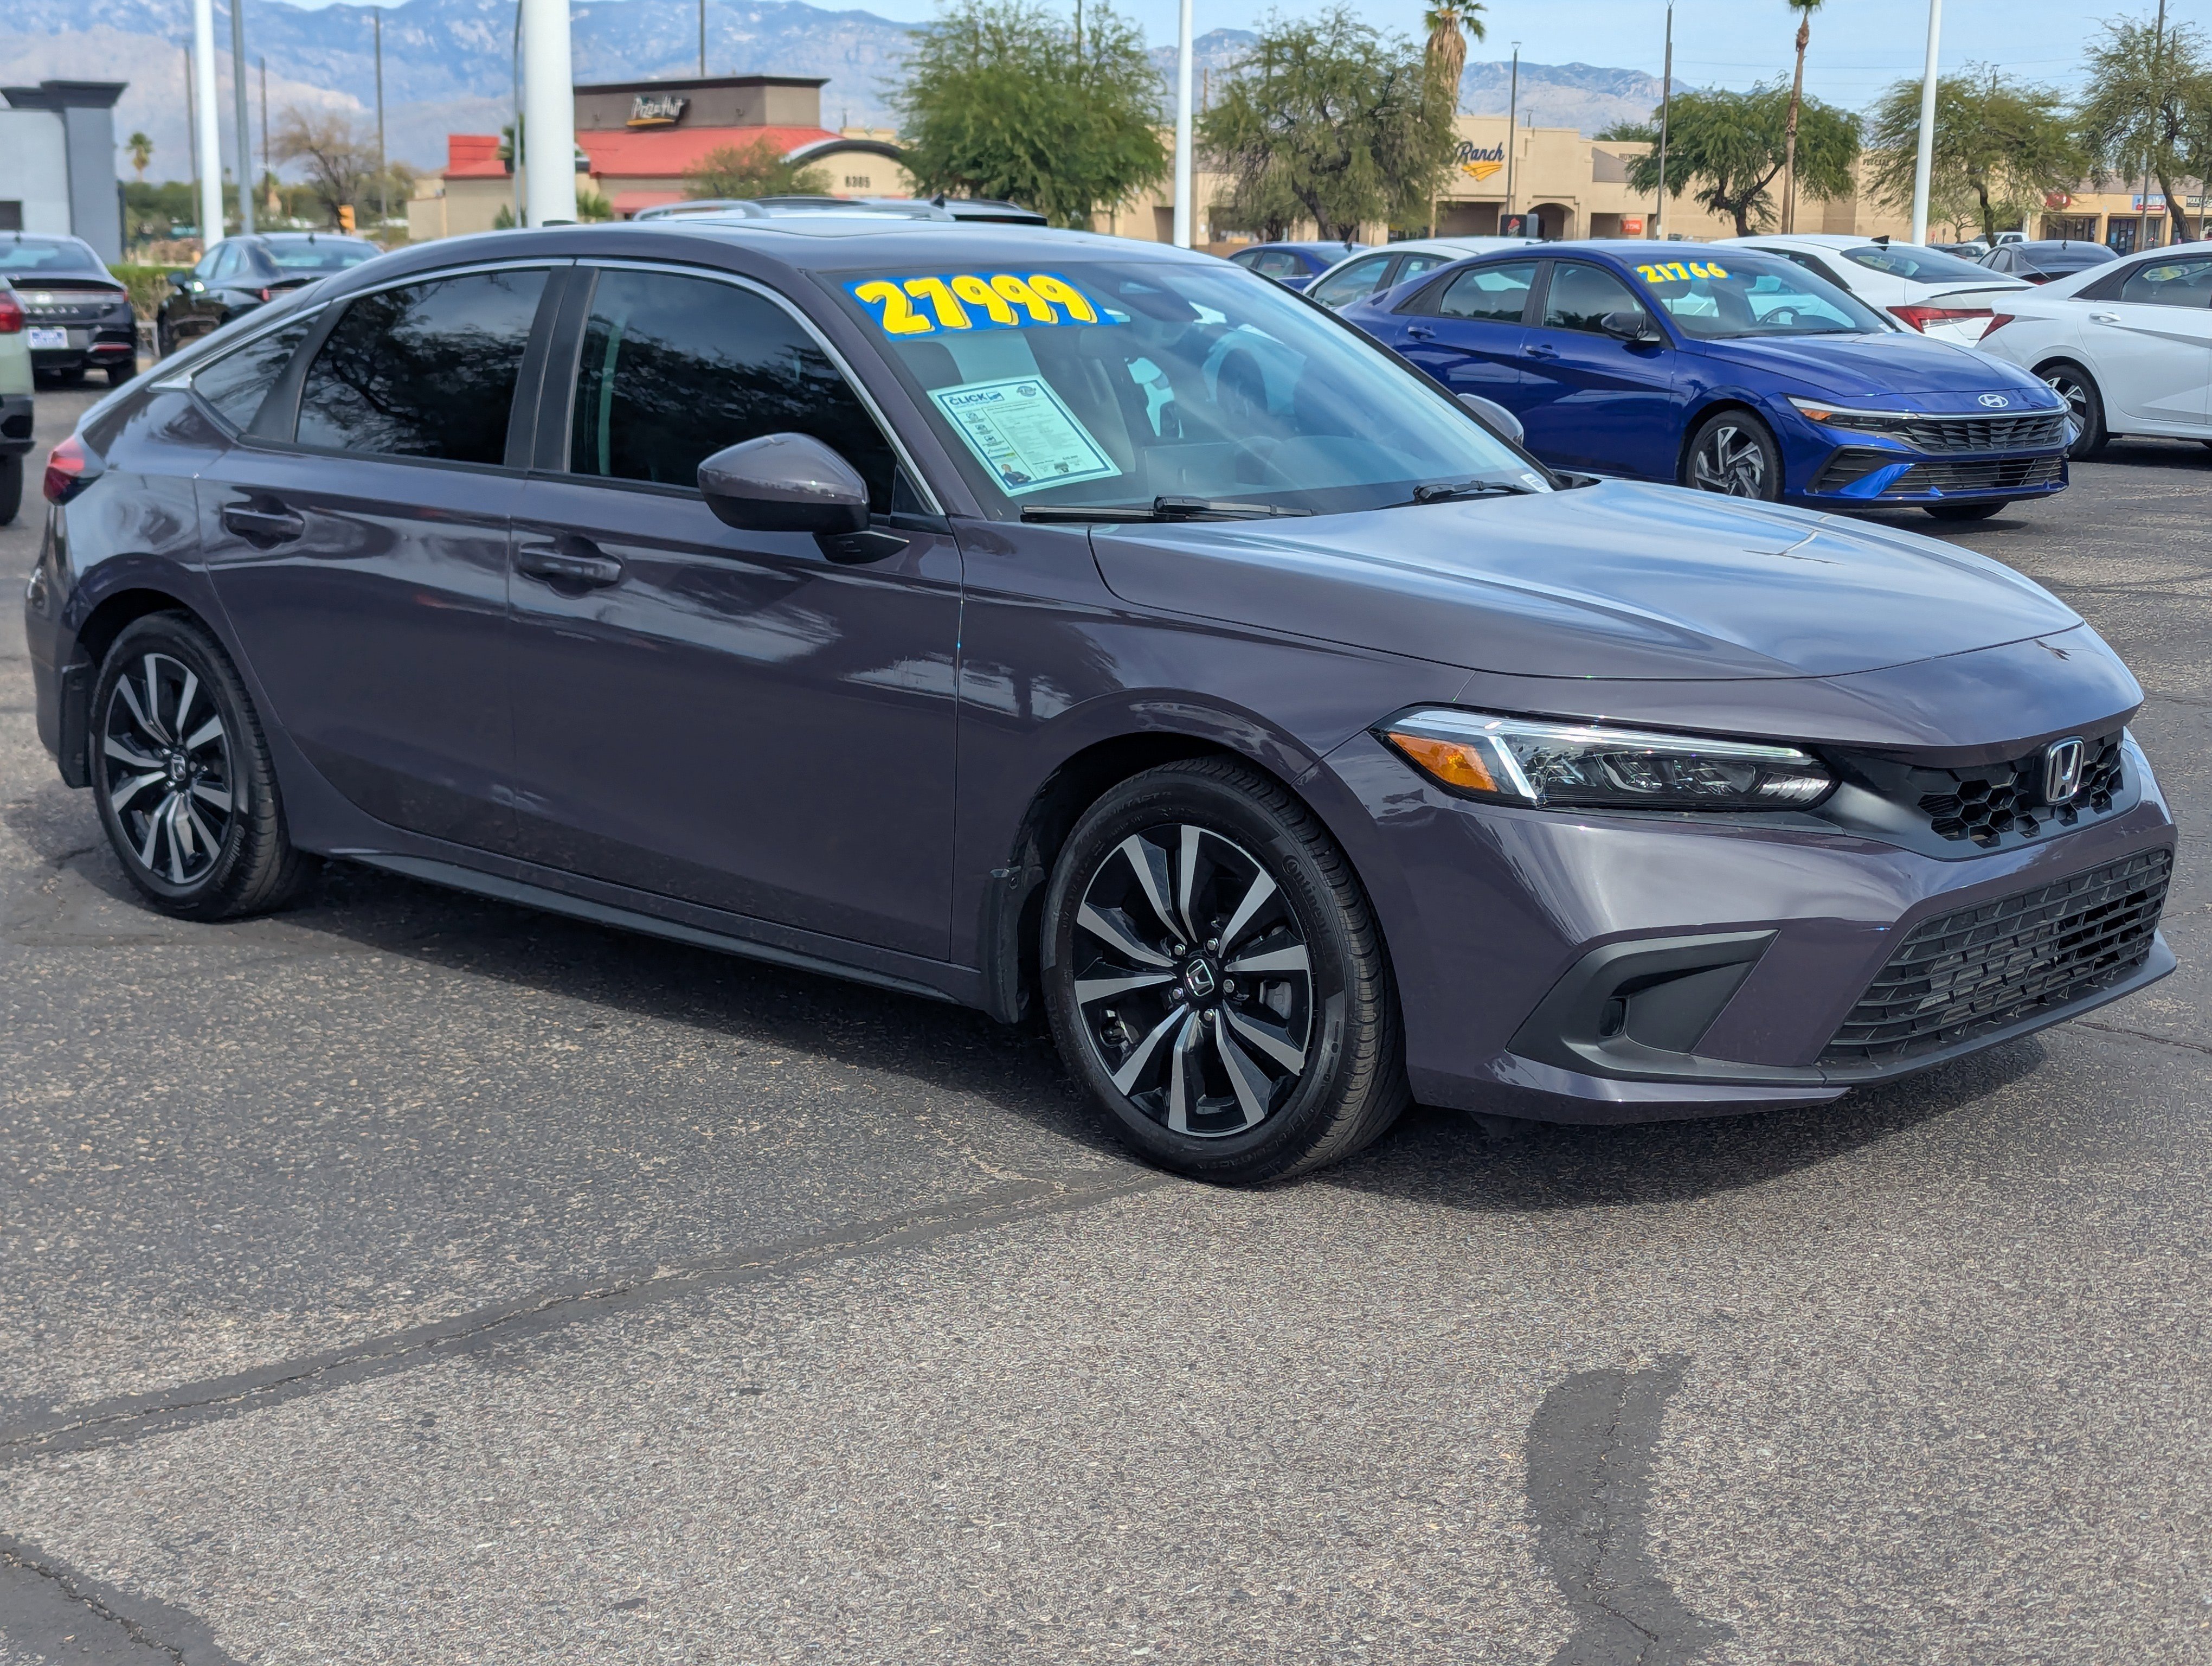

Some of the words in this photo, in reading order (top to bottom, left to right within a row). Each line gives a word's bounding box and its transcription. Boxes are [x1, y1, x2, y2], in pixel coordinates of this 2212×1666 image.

[661, 95, 685, 117] Hut
[1455, 141, 1504, 165] Ranch
[1637, 262, 1728, 283] 21766
[854, 274, 1098, 335] 27999
[949, 393, 987, 405] CLICK
